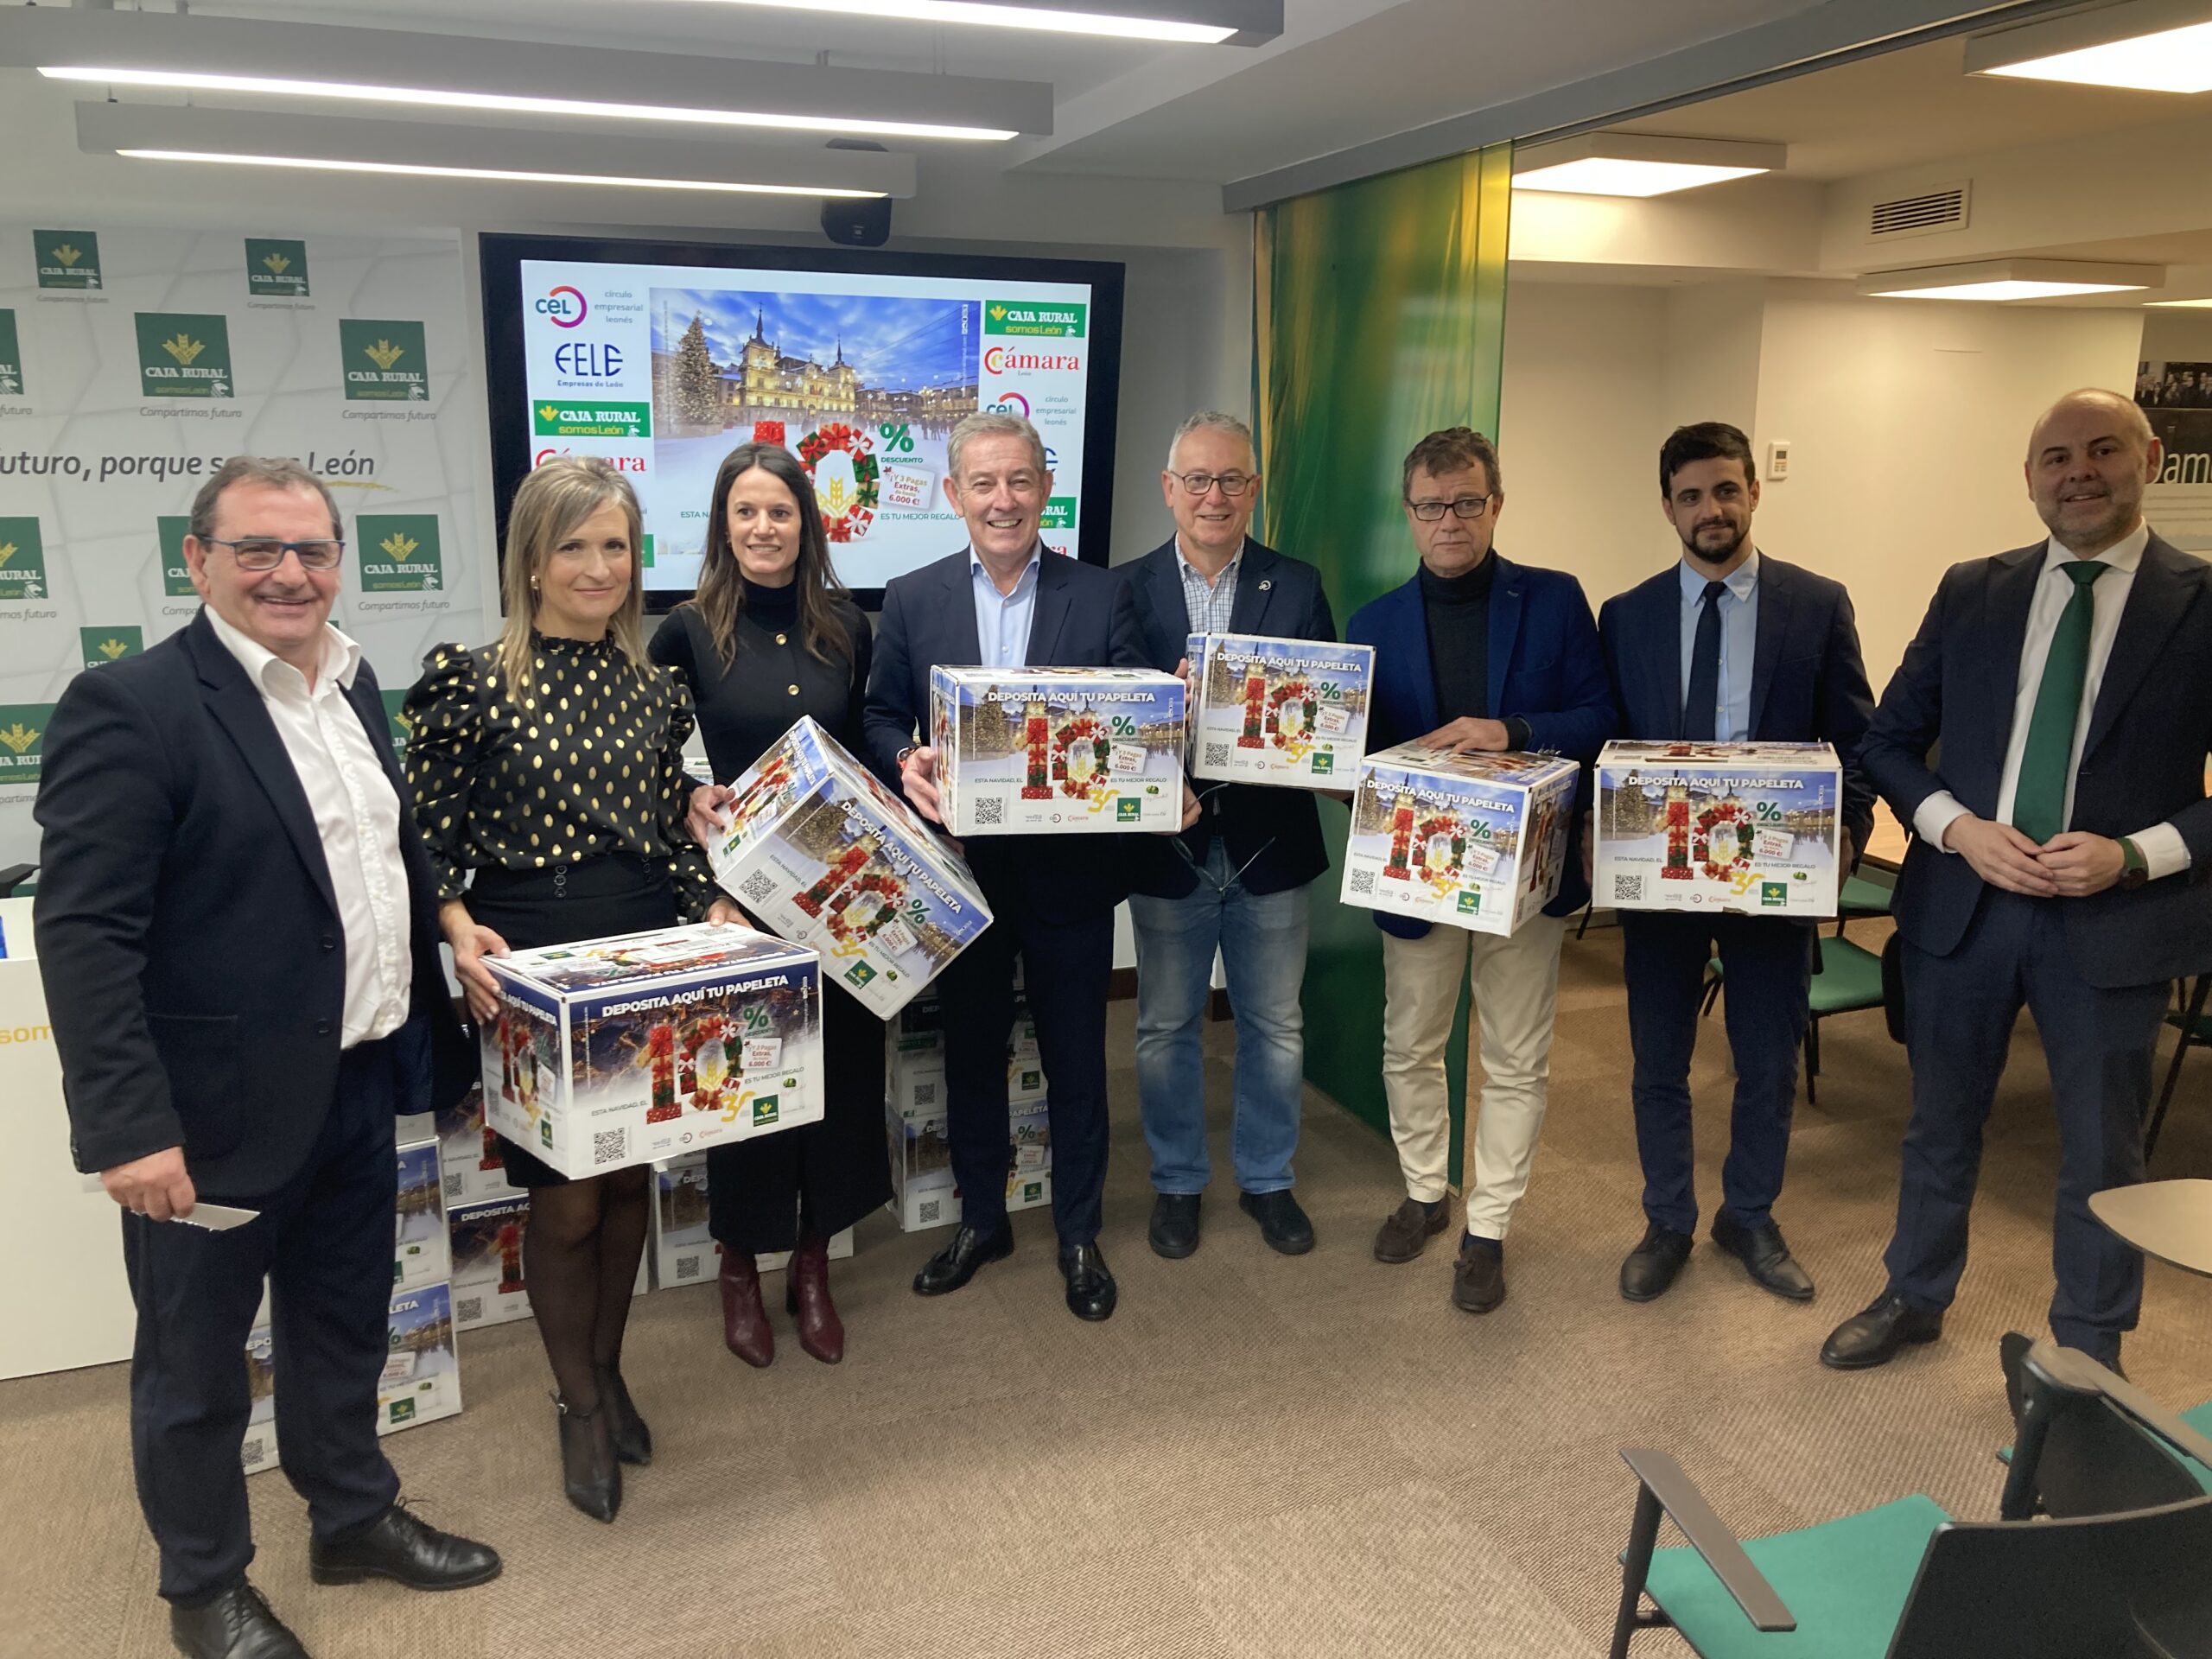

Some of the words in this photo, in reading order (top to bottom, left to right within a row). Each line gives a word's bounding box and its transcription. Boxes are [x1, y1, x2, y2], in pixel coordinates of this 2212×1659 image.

[604, 290, 632, 299] círculo
[594, 302, 644, 313] empresarial
[606, 315, 633, 324] leonés
[1007, 310, 1037, 323] CAJA
[1039, 311, 1078, 324] RURAL
[984, 346, 1080, 375] Cámara
[145, 366, 179, 378] CAJA
[181, 367, 228, 379] RURAL
[347, 371, 379, 382] CAJA
[381, 372, 424, 383] RURAL
[557, 379, 593, 389] Empresas
[606, 380, 624, 389] León
[140, 406, 209, 419] Compartimos
[209, 406, 242, 420] futuro
[342, 410, 406, 421] Compartimos
[406, 410, 437, 421] futuro
[560, 410, 594, 423] CAJA
[595, 410, 641, 423] RURAL
[1036, 407, 1077, 416] empresarial
[879, 422, 915, 453] %
[0, 451, 92, 482] uturo,
[99, 455, 202, 482] porque
[308, 449, 375, 476] León
[893, 481, 920, 493] Extras,
[906, 475, 927, 486] Pagas
[888, 494, 911, 505] 6.000
[364, 563, 395, 575] CAJA
[397, 563, 438, 574] RURAL
[358, 601, 421, 613] Compartimos
[420, 600, 450, 612] futuro
[23, 608, 58, 621] futuro
[1217, 652, 1267, 664] DEPOSITA
[1268, 656, 1295, 667] AQUÍ
[1296, 658, 1309, 668] TU
[1310, 660, 1362, 672] PAPELETA
[988, 692, 1046, 702] DEPOSITA
[1048, 690, 1078, 703] AQUÍ
[1080, 692, 1096, 702] TU
[1098, 692, 1155, 702] PAPELETA
[1629, 776, 1688, 786] DEPOSITA
[1690, 775, 1720, 787] AQUÍ
[1723, 778, 1739, 787] TU
[1741, 779, 1803, 789] PAPELETA
[1366, 779, 1417, 797] DEPOSITA
[1418, 786, 1445, 802] AQUÍ
[1446, 792, 1460, 804] TU
[1460, 795, 1515, 813] PAPELETA
[841, 801, 887, 845] DEPOSITA
[884, 842, 910, 865] AQUÍ
[908, 860, 922, 875] TU
[918, 871, 963, 915] PAPELETA
[880, 950, 895, 965] MEJOR
[893, 962, 911, 978] REGALO
[601, 995, 671, 1018] DEPOSITA
[672, 987, 706, 1006] AQUÍ
[706, 986, 725, 998] TU
[726, 975, 789, 995] PAPELETA
[760, 1071, 781, 1081] MEJOR
[781, 1066, 804, 1077] REGALO
[1017, 1123, 1036, 1141] %
[461, 1205, 515, 1222] DEPOSITA
